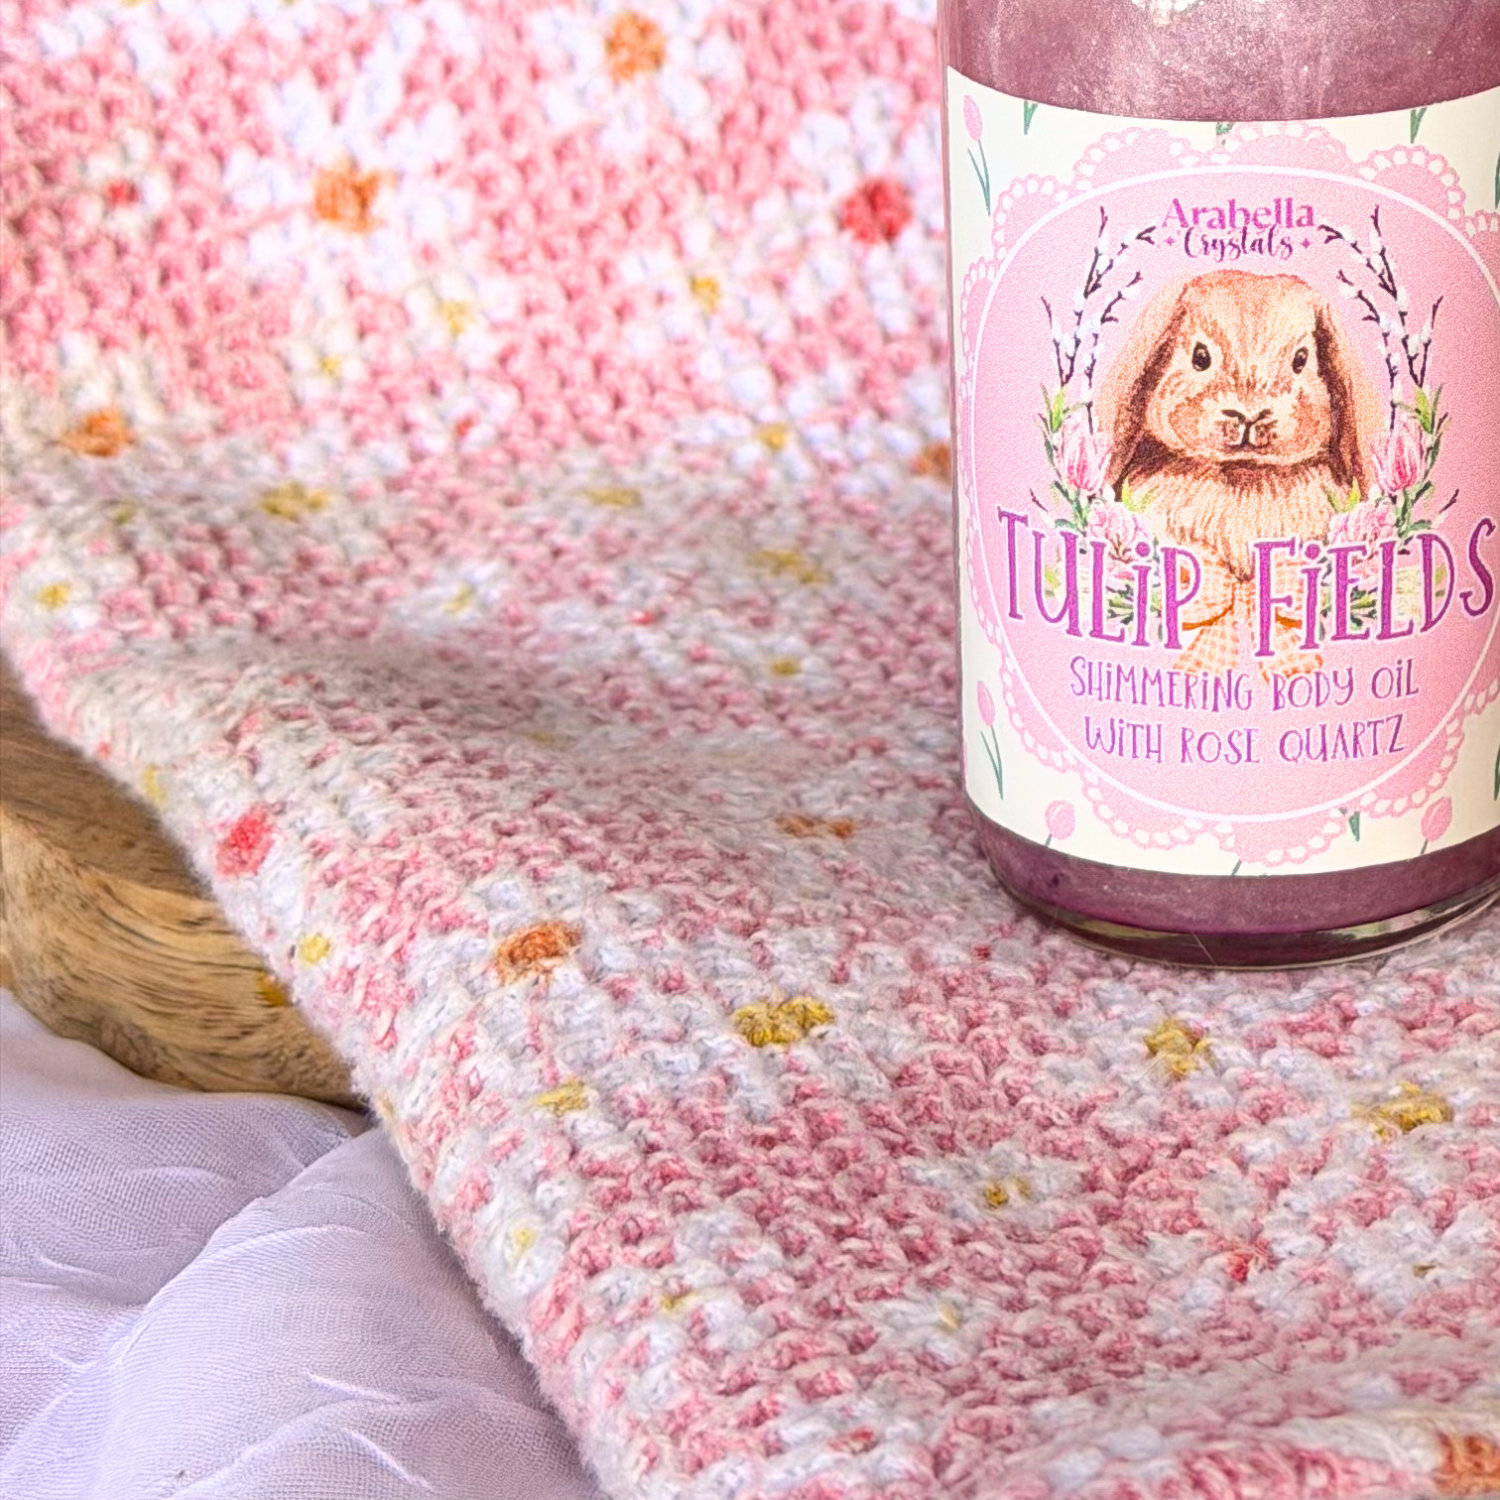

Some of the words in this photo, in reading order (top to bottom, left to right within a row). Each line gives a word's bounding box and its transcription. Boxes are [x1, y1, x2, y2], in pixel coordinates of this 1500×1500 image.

[1162, 197, 1315, 230] Arabella
[1184, 225, 1294, 263] Crystals
[1272, 666, 1354, 712] BODY
[1180, 726, 1261, 765] ROSE
[1278, 713, 1405, 763] QUARTZ
